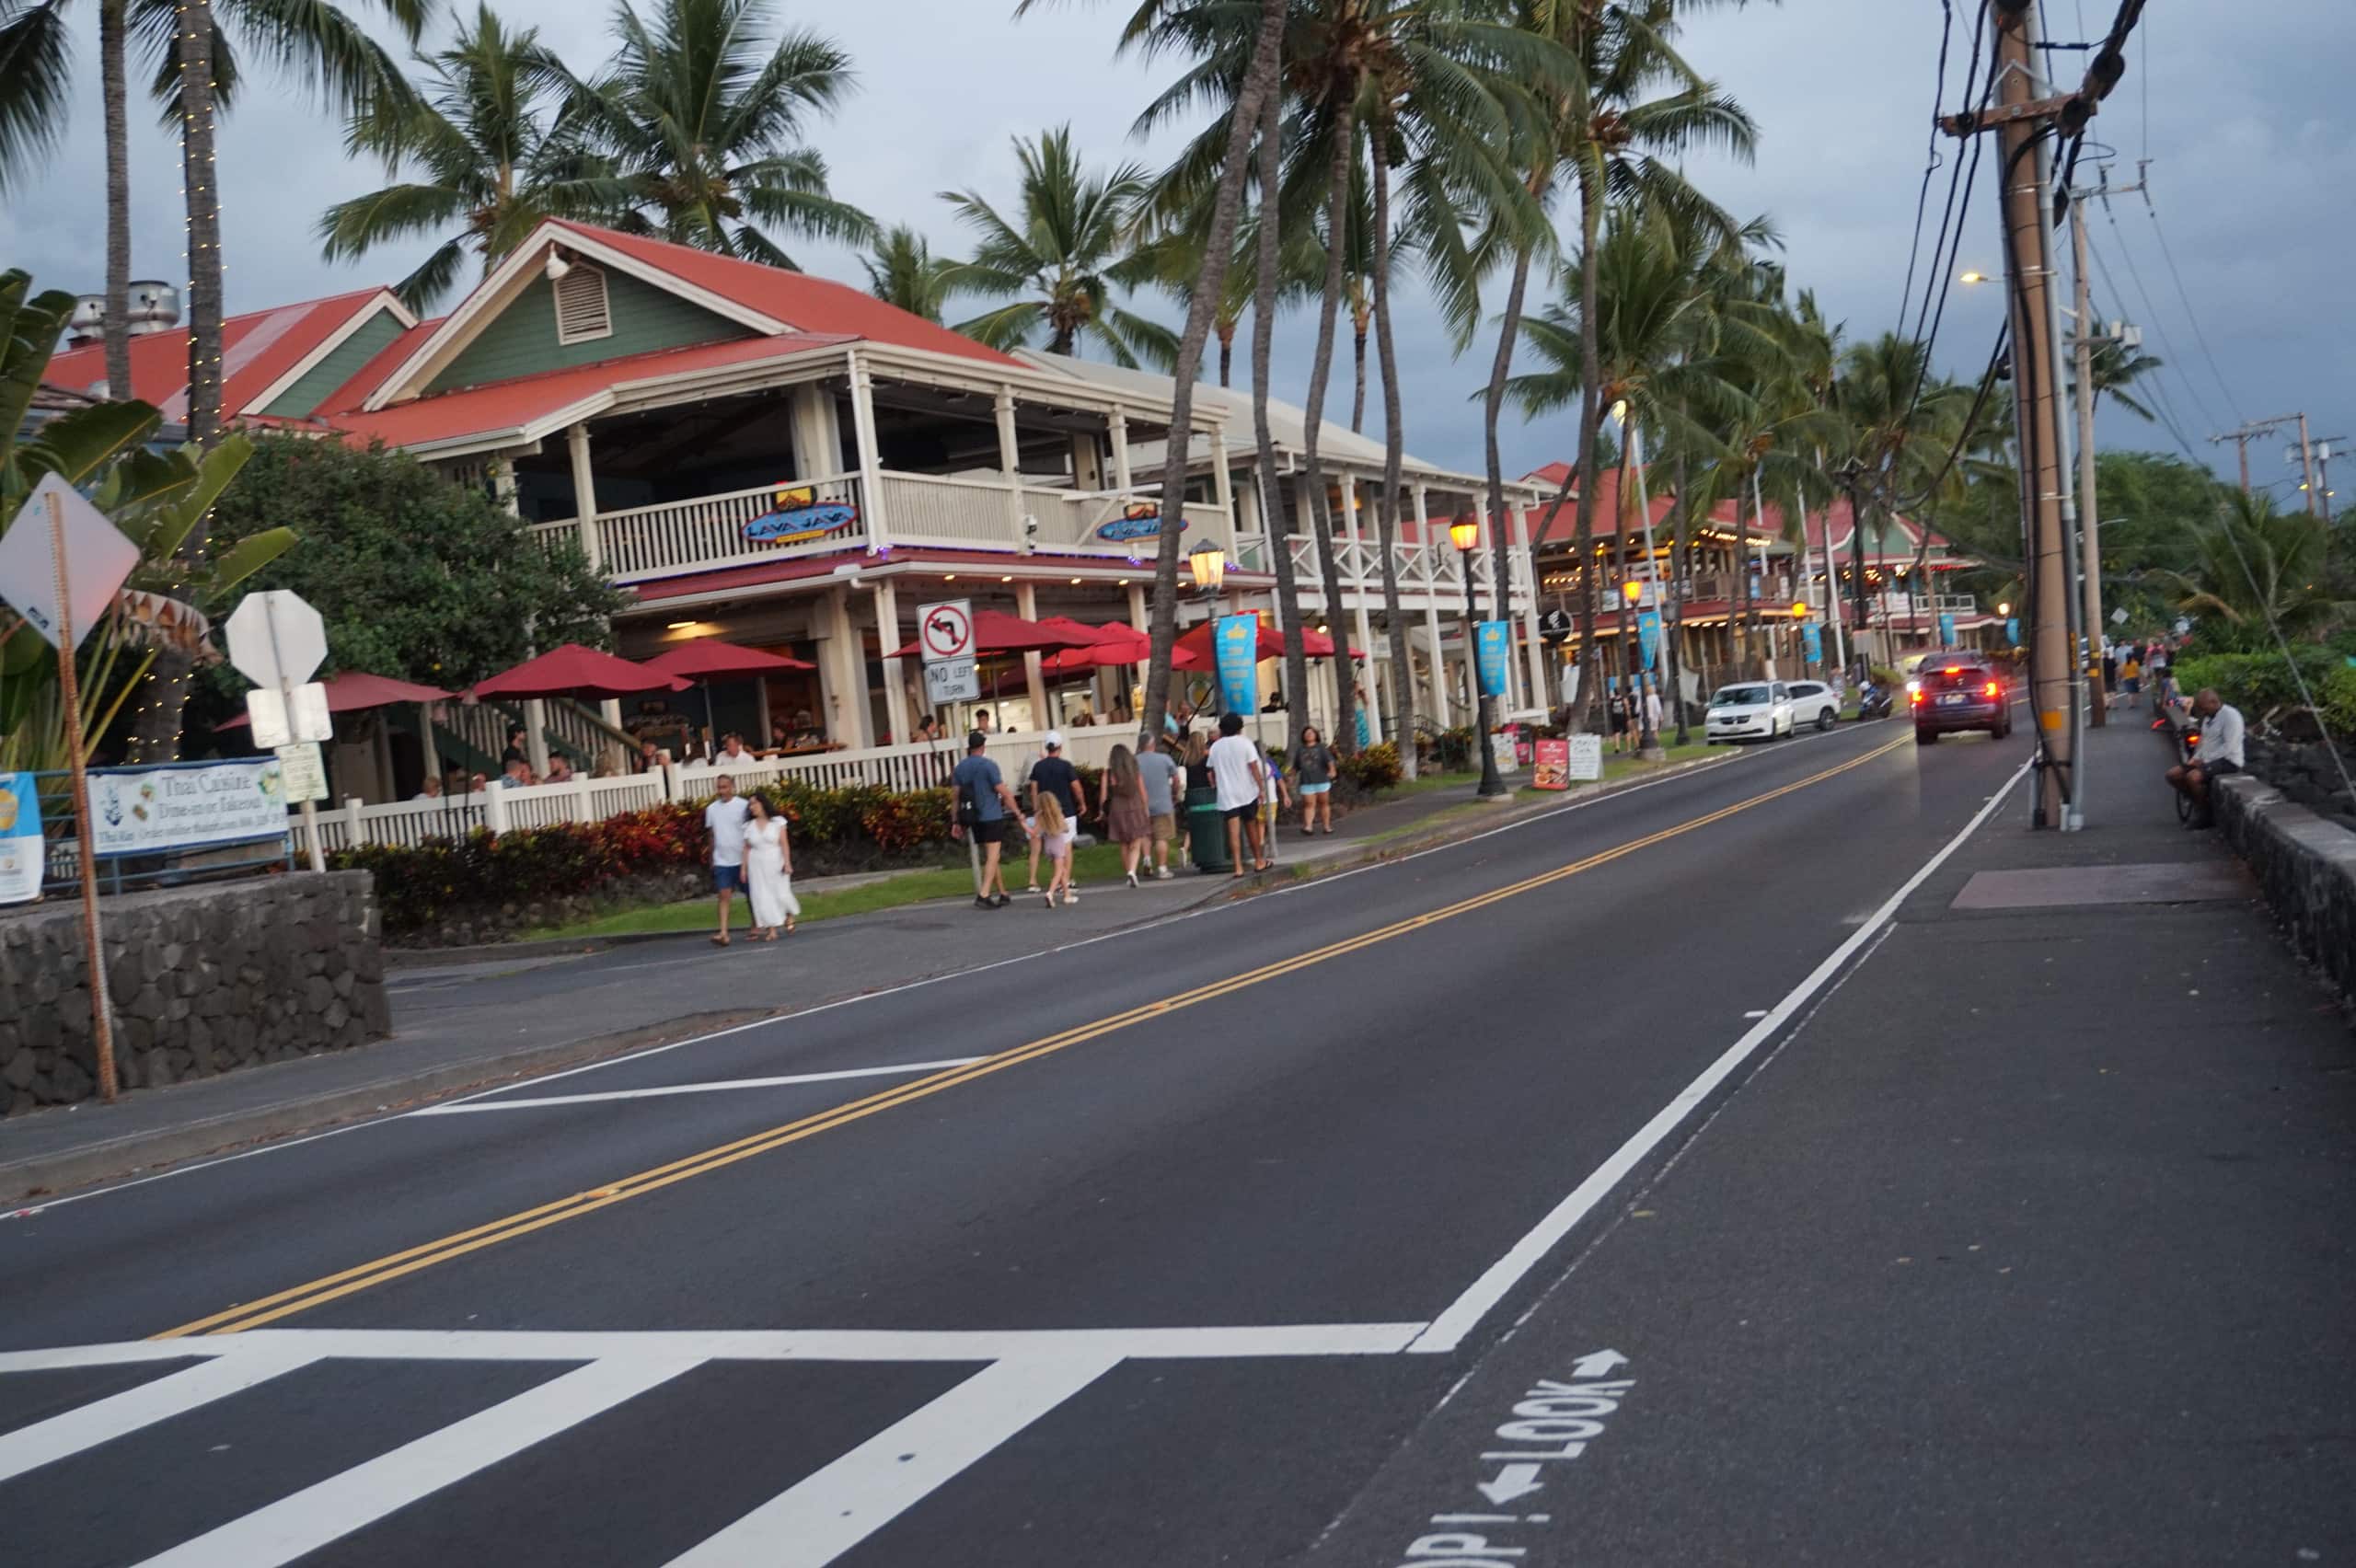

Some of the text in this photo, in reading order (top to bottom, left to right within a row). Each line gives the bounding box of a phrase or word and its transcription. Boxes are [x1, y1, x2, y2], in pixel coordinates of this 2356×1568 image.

[746, 521, 798, 536] LAVA
[801, 512, 851, 528] JAVA
[930, 664, 974, 683] NO LEFT
[942, 684, 965, 697] TURN
[161, 772, 252, 797] Thai Cuisine
[1479, 1379, 1637, 1459] LOOK
